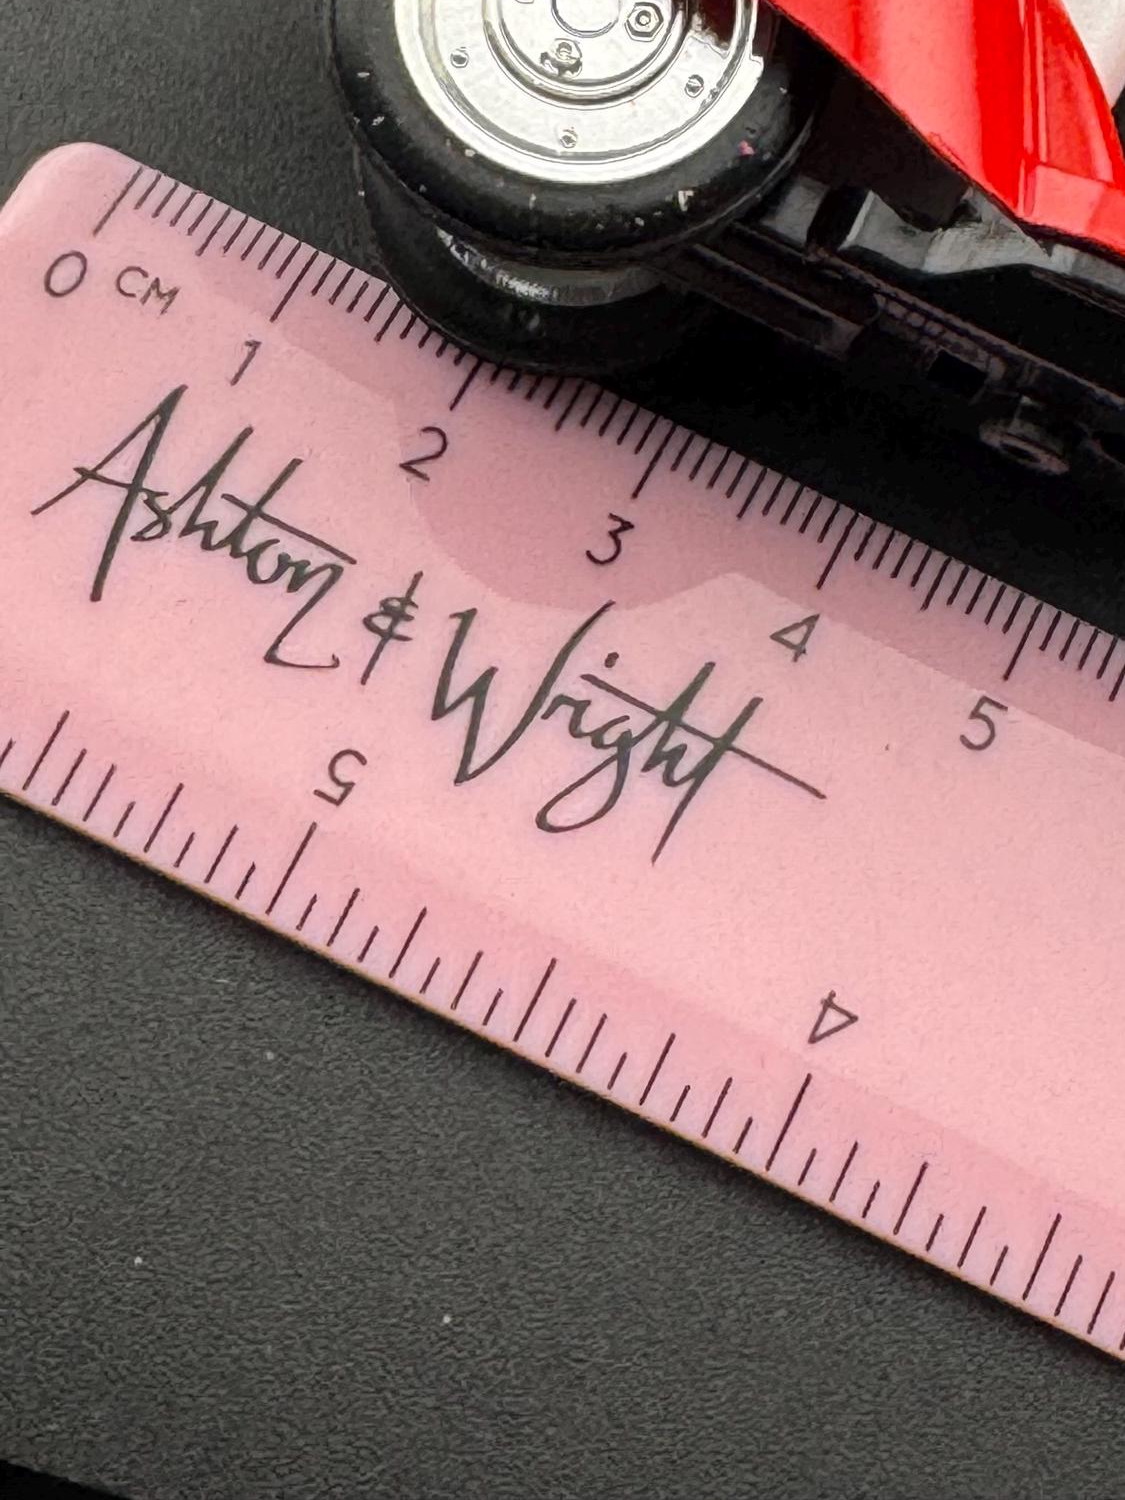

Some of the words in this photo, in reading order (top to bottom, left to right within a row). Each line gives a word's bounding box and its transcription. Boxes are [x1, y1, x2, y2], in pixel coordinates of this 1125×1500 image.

[30, 383, 357, 669] Ashton
[430, 600, 827, 866] Wright
[44, 250, 87, 298] 0
[115, 266, 181, 316] CM
[230, 340, 261, 386] 1
[398, 426, 449, 482] 2
[585, 513, 635, 566] 3
[769, 614, 820, 663] 4
[960, 696, 1008, 751] 5
[313, 748, 367, 807] 5
[808, 990, 859, 1044] 4
